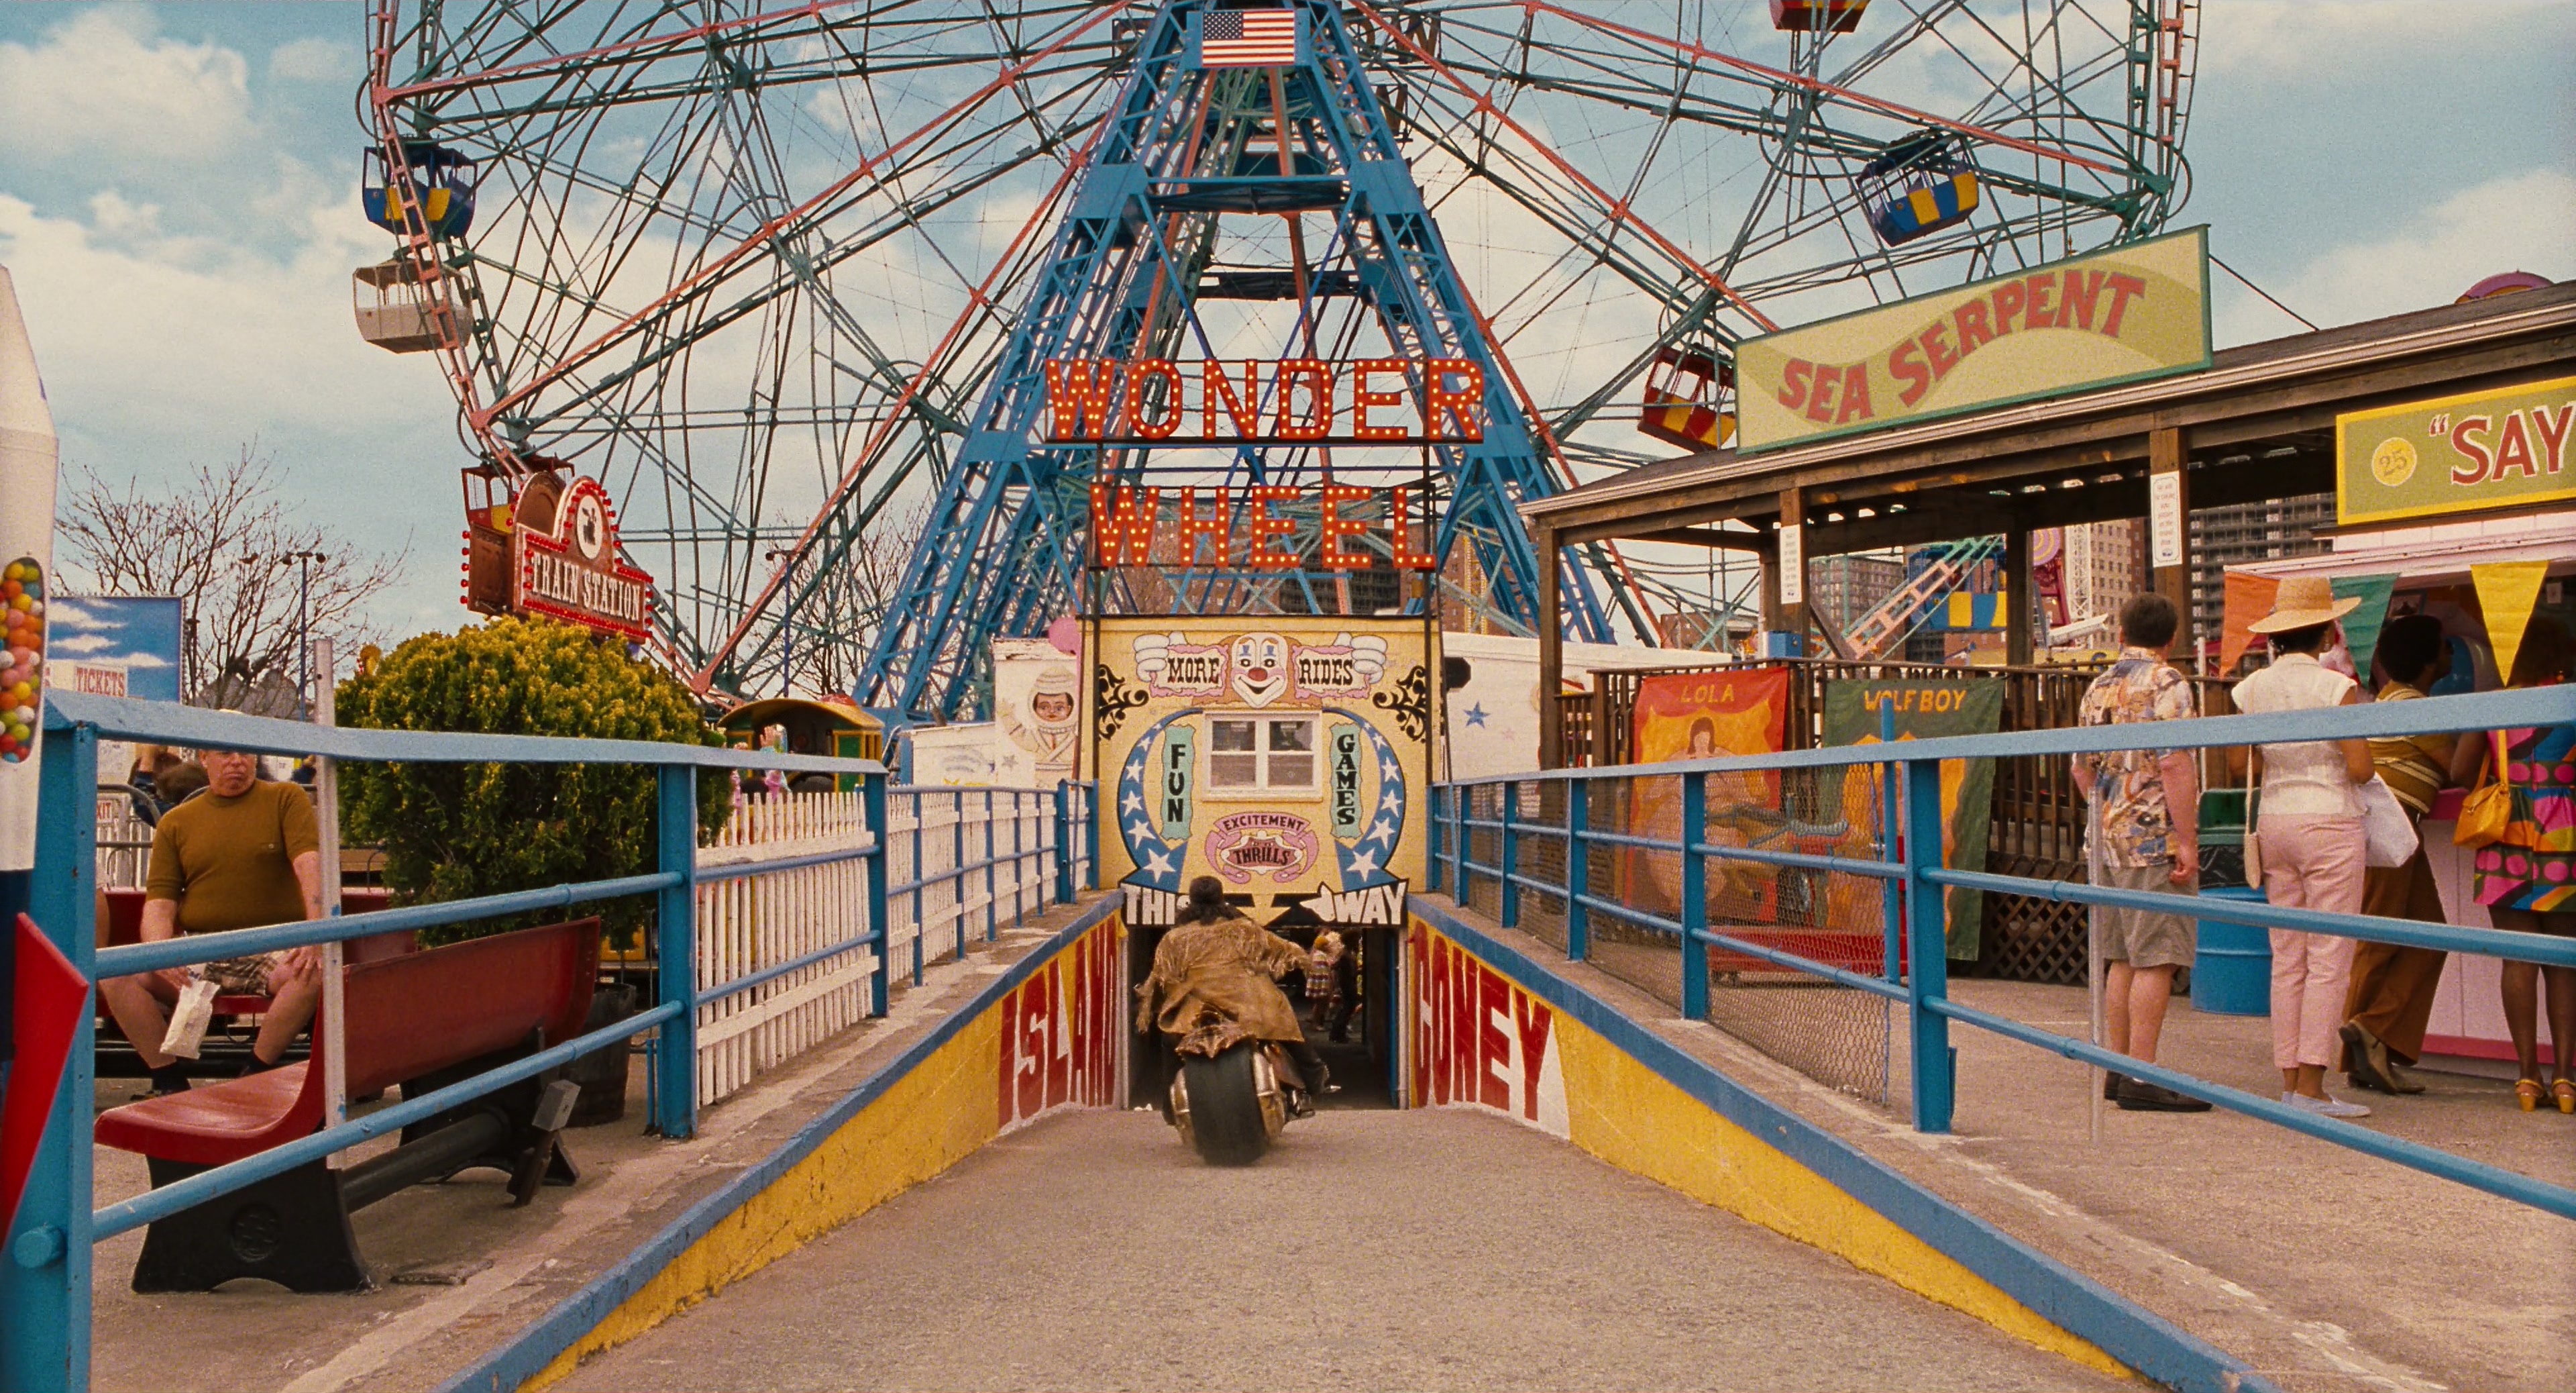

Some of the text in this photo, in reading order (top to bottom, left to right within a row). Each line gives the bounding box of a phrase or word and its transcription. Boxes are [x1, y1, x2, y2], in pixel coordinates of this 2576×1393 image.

[1778, 270, 2146, 425] SEA SERPENT
[1044, 358, 1484, 440] WONDER
[1090, 485, 1436, 568] WHEEL
[531, 552, 641, 621] TRAIN STATION
[76, 667, 125, 697] TICKETS
[1167, 657, 1353, 686] MORE RIDES
[1680, 684, 1735, 703] LOLA
[1919, 688, 1967, 713] BOY
[1167, 743, 1186, 823] FUN
[1336, 733, 1357, 825] GAMES
[1222, 815, 1305, 831] EXCITEMENT
[1234, 846, 1291, 866] THRILLS
[1334, 881, 1408, 925] WAY
[998, 914, 1118, 1129] ISLAND
[1413, 920, 1552, 1122] CONEY
